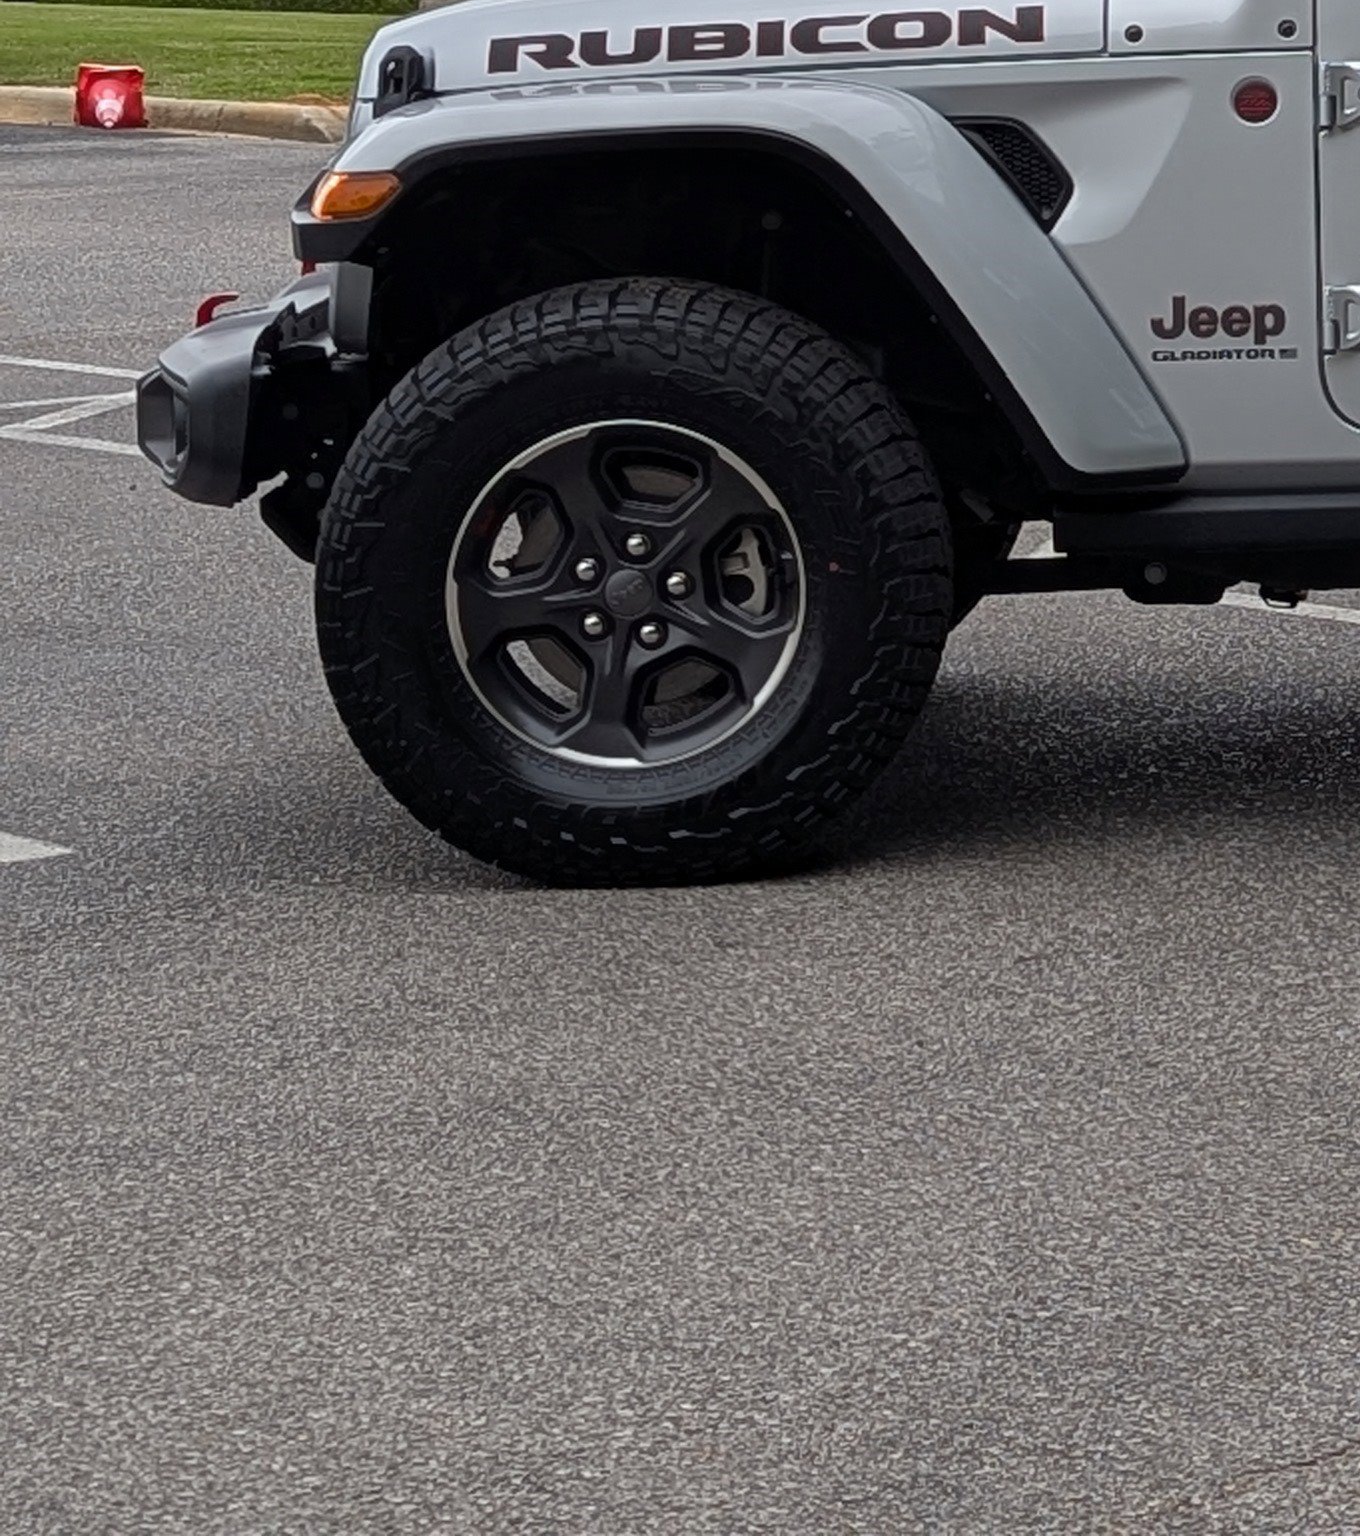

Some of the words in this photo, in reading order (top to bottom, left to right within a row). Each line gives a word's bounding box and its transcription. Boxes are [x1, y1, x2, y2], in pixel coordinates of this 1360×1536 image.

[487, 5, 1045, 74] RUBICON
[1150, 295, 1286, 345] Jeep
[1151, 348, 1276, 362] GLADIATOR
